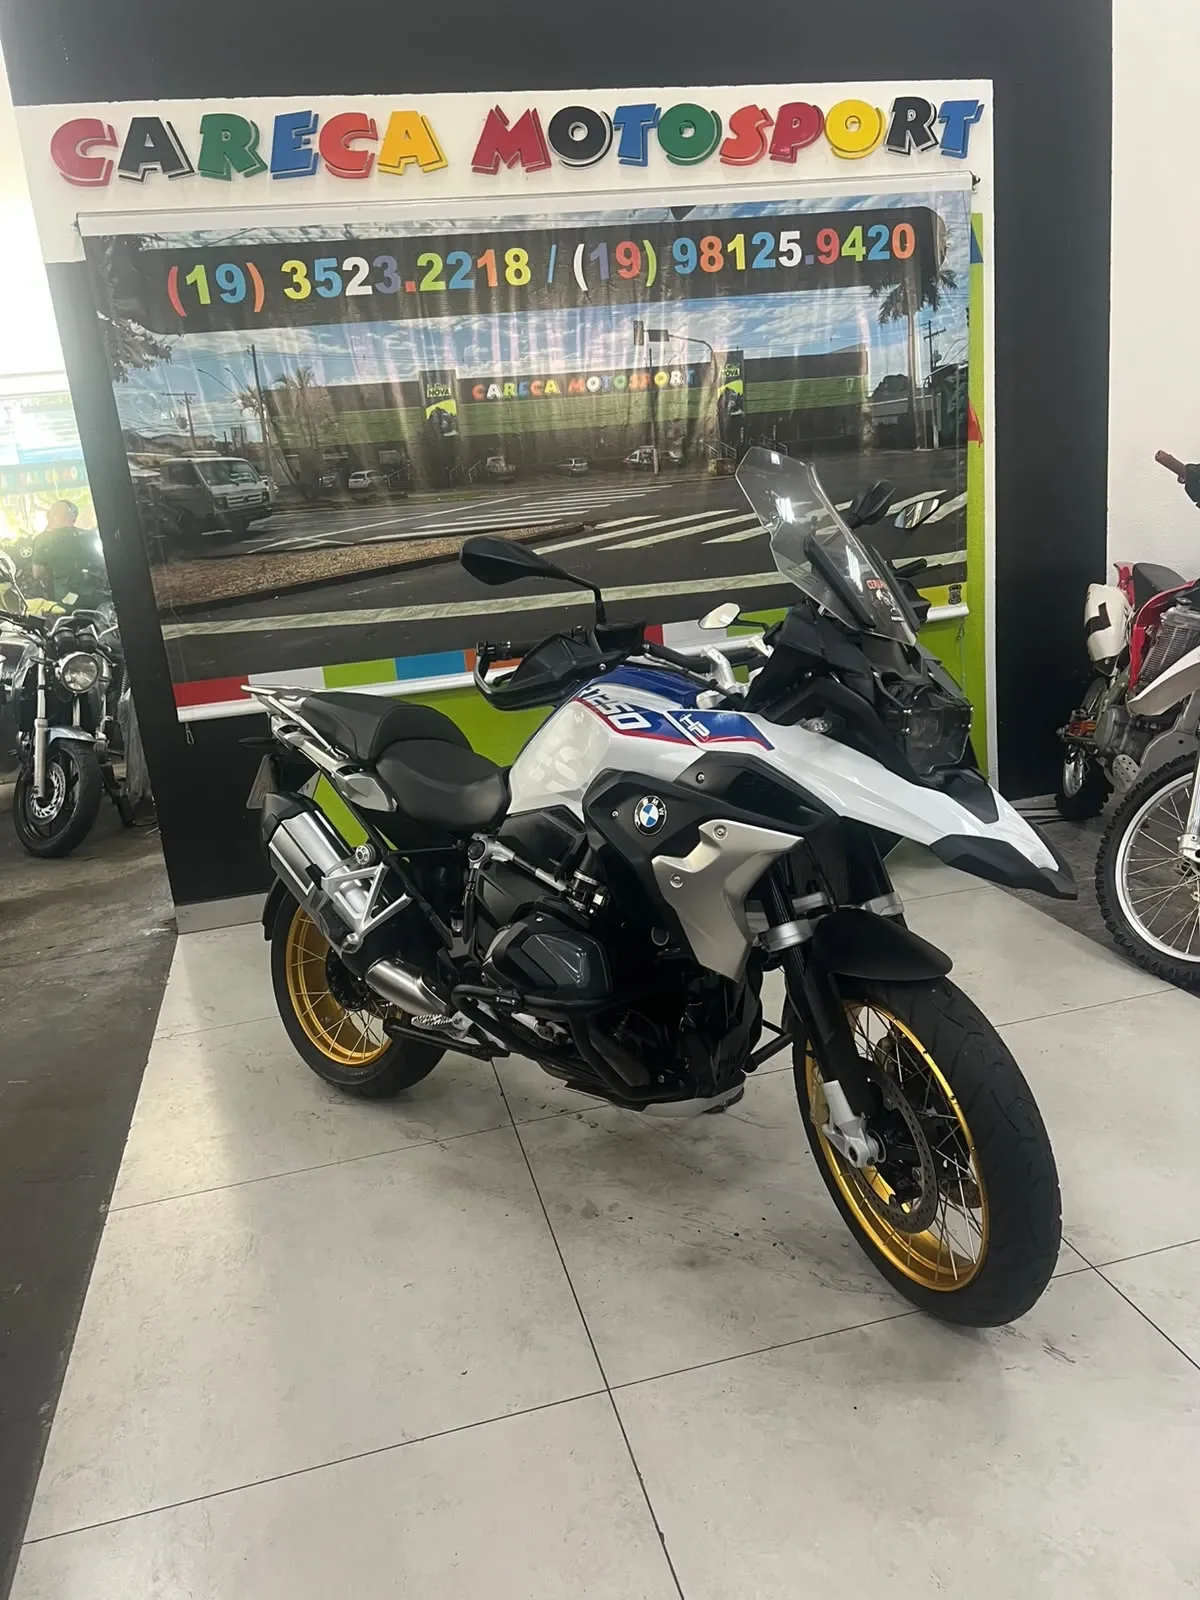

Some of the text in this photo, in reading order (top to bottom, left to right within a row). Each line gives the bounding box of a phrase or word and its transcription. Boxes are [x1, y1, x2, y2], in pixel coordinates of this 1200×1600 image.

[50, 96, 984, 187] CARECA MOTOSPORT
[167, 262, 265, 317] (19)
[280, 247, 532, 300] 3523.2218
[574, 239, 657, 292] (19)
[672, 222, 917, 276] 98125.9420
[428, 387, 450, 398] NOVA
[471, 379, 562, 401] CARECA
[680, 713, 711, 738] HP
